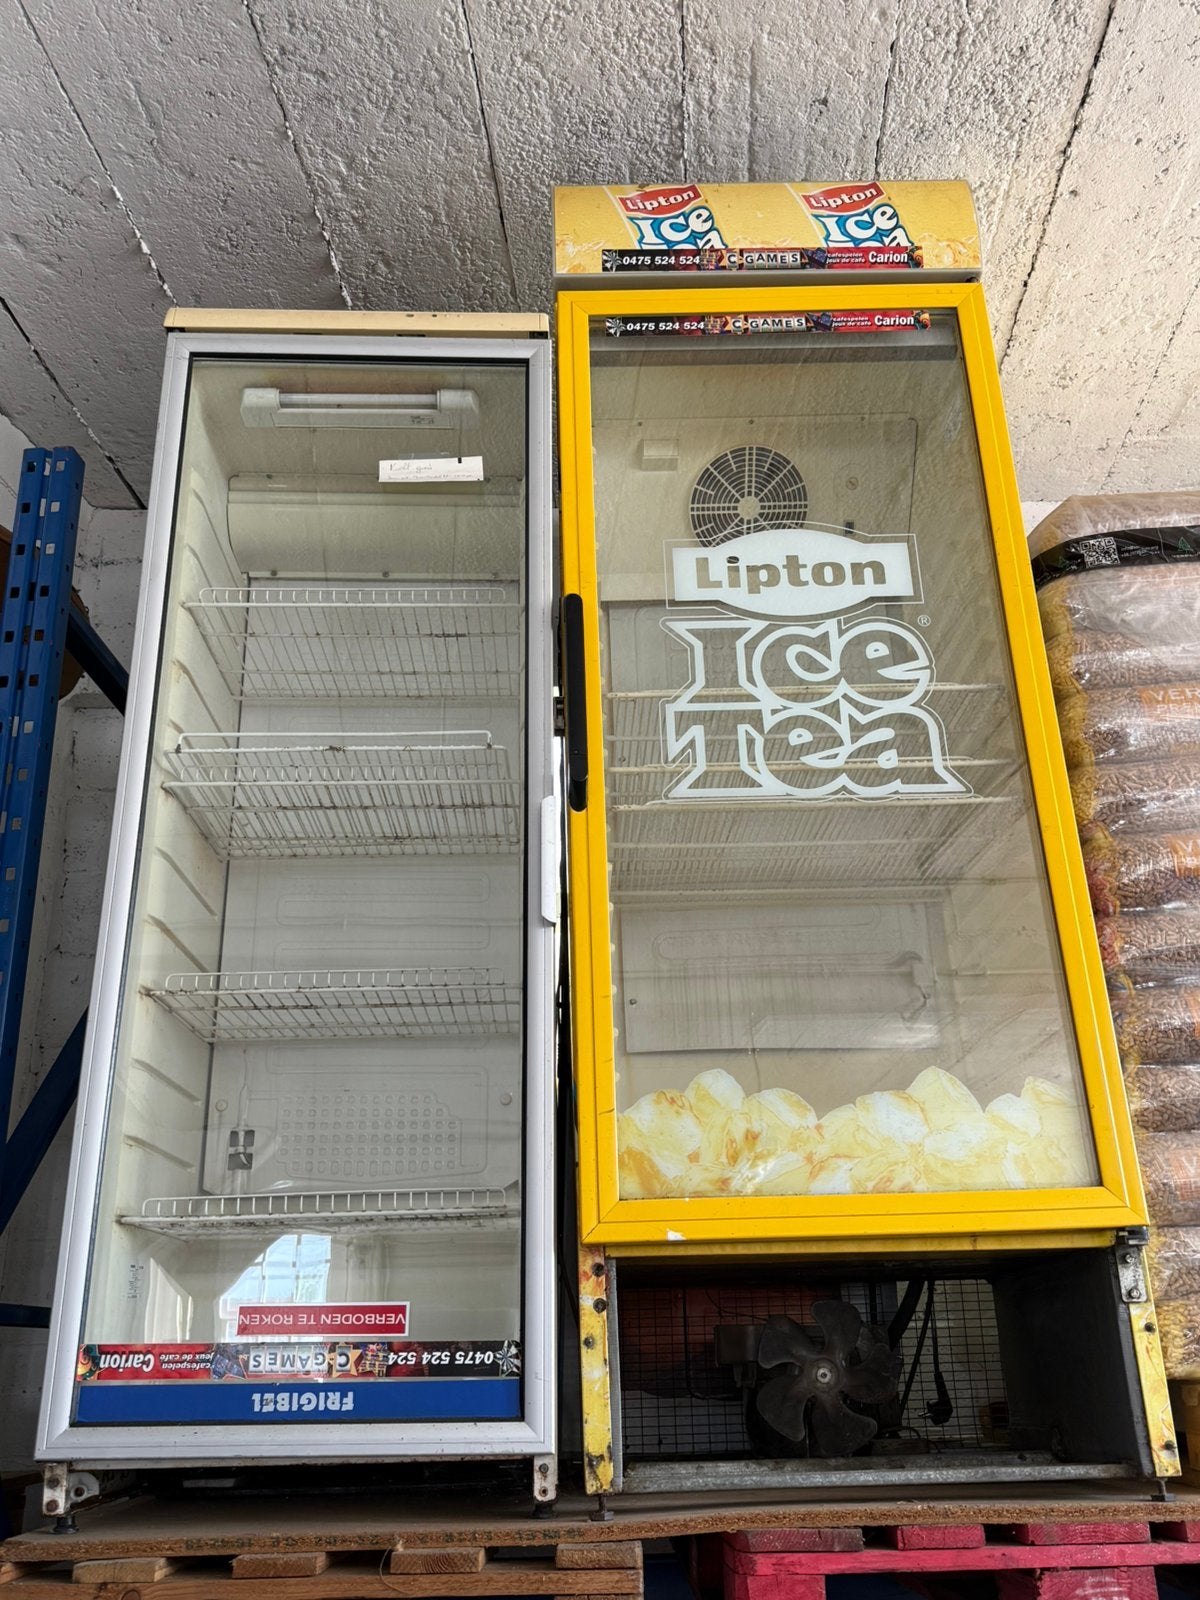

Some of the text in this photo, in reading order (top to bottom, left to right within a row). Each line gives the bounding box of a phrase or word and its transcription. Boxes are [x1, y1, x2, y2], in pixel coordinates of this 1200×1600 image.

[625, 190, 695, 211] Lipton
[808, 188, 878, 209] Lipton
[631, 206, 714, 245] Ice
[816, 203, 899, 243] Ice
[623, 255, 700, 265] 0475 524 524
[868, 250, 908, 263] Carion
[626, 321, 705, 331] 0475 524 524
[874, 314, 914, 326] Carion
[695, 555, 887, 594] Lipton
[664, 619, 931, 706] Ice
[664, 697, 967, 797] Tea
[238, 1313, 406, 1326] VERBODEN TE ROKEN
[100, 1353, 154, 1373] Carion
[182, 1353, 193, 1362] de
[194, 1351, 215, 1362] jeux
[388, 1351, 494, 1365] 0475 524 524
[251, 1391, 355, 1412] FRIGIBEL
